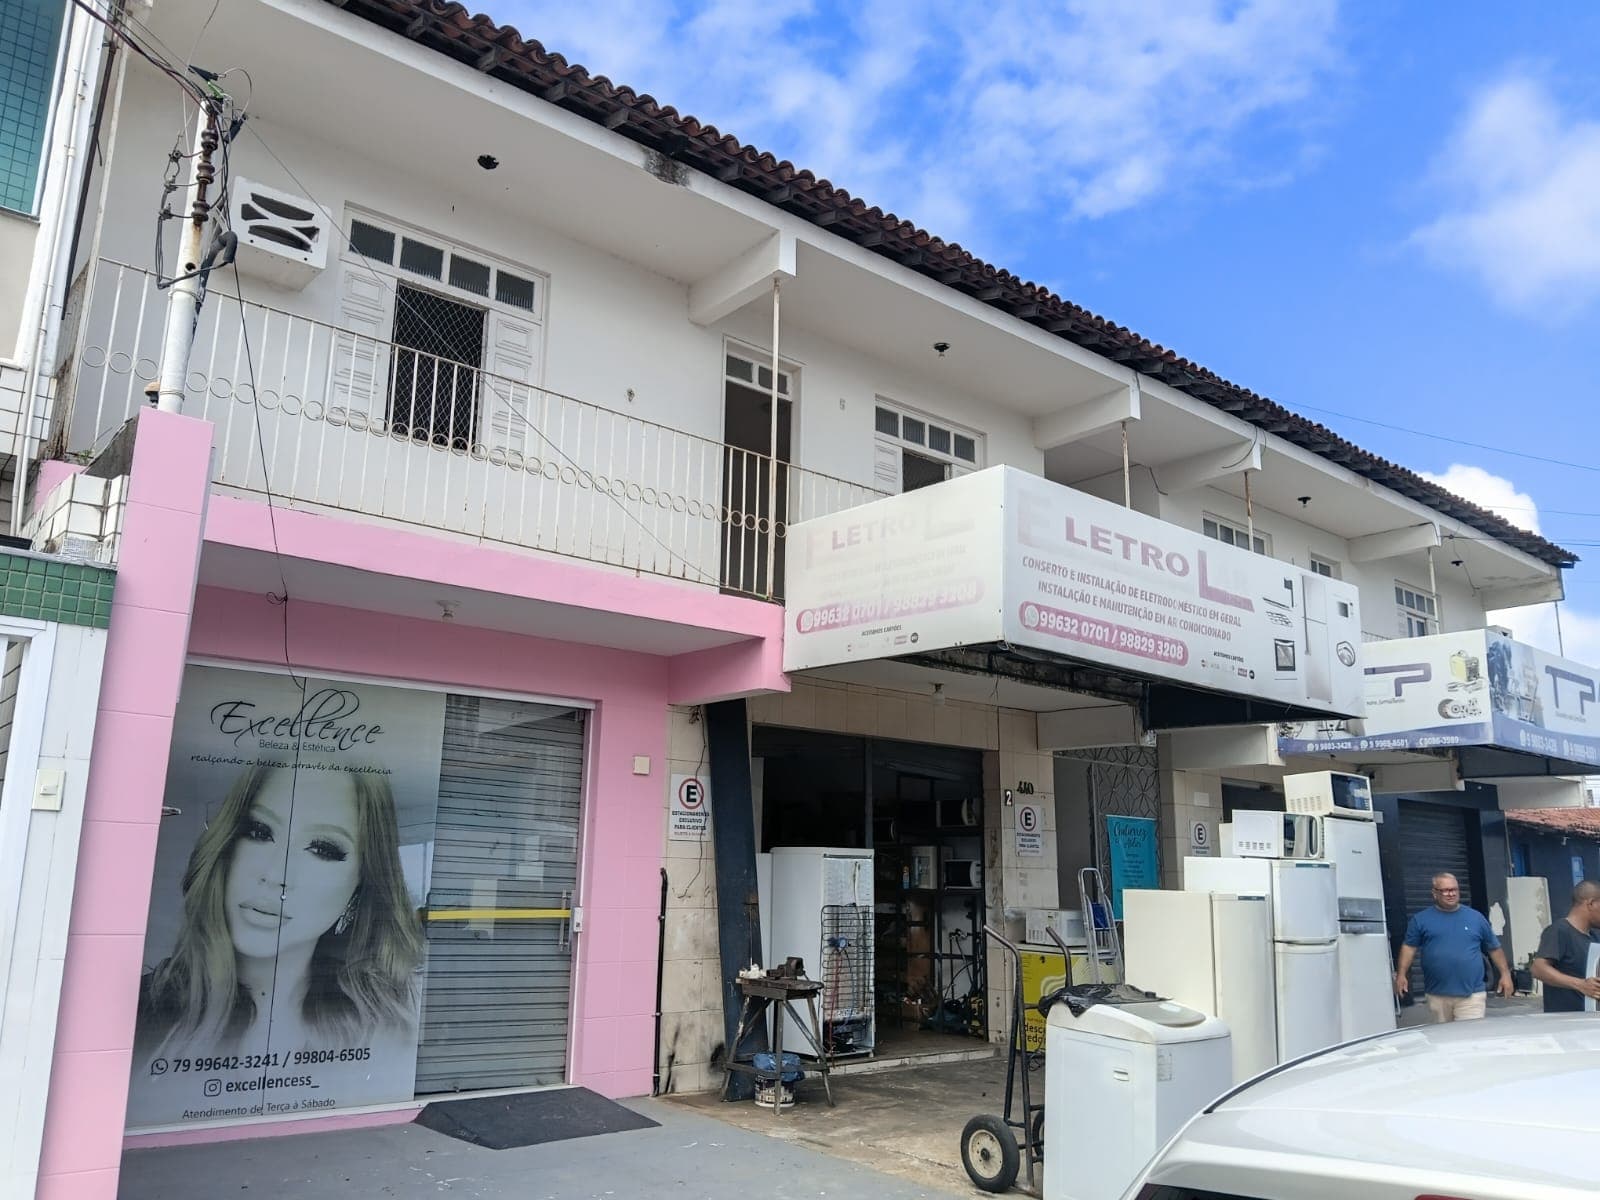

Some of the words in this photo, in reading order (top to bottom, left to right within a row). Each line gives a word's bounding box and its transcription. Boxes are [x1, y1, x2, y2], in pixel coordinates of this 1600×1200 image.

[1022, 555, 1068, 579] CONSERTO
[1070, 570, 1076, 581] E
[1077, 571, 1127, 595] INSTALAÇÃO
[1129, 585, 1139, 598] DE
[1209, 607, 1219, 620] EM
[1220, 612, 1242, 628] GERAL
[1038, 580, 1091, 605] INSTALAÇÃO
[1093, 595, 1098, 606] E
[1100, 596, 1153, 624] MANUTENÇÃO
[1155, 610, 1166, 624] EM
[1179, 618, 1231, 642] CONDICIONADO
[1039, 611, 1078, 635] 99632
[1081, 622, 1110, 642] 0701
[1111, 628, 1118, 643] /
[1119, 632, 1155, 655] 98829
[1157, 640, 1184, 661] 3208
[211, 689, 385, 750] Excellence
[259, 739, 289, 750] Beleza
[302, 741, 336, 753] Estética
[191, 754, 242, 766] realçando
[256, 758, 289, 769] beleza
[328, 762, 341, 772] da
[344, 763, 393, 775] excelência
[687, 785, 697, 802] E
[1024, 812, 1032, 826] E
[1197, 827, 1203, 840] E
[173, 1058, 191, 1073] 79
[195, 1053, 279, 1072] 99642-3241
[282, 1051, 291, 1068] /
[294, 1048, 370, 1066] 99804-6505
[182, 1105, 247, 1120] Atendimento
[250, 1103, 262, 1114] de
[266, 1101, 290, 1114] Terça
[301, 1097, 336, 1109] Sábado
